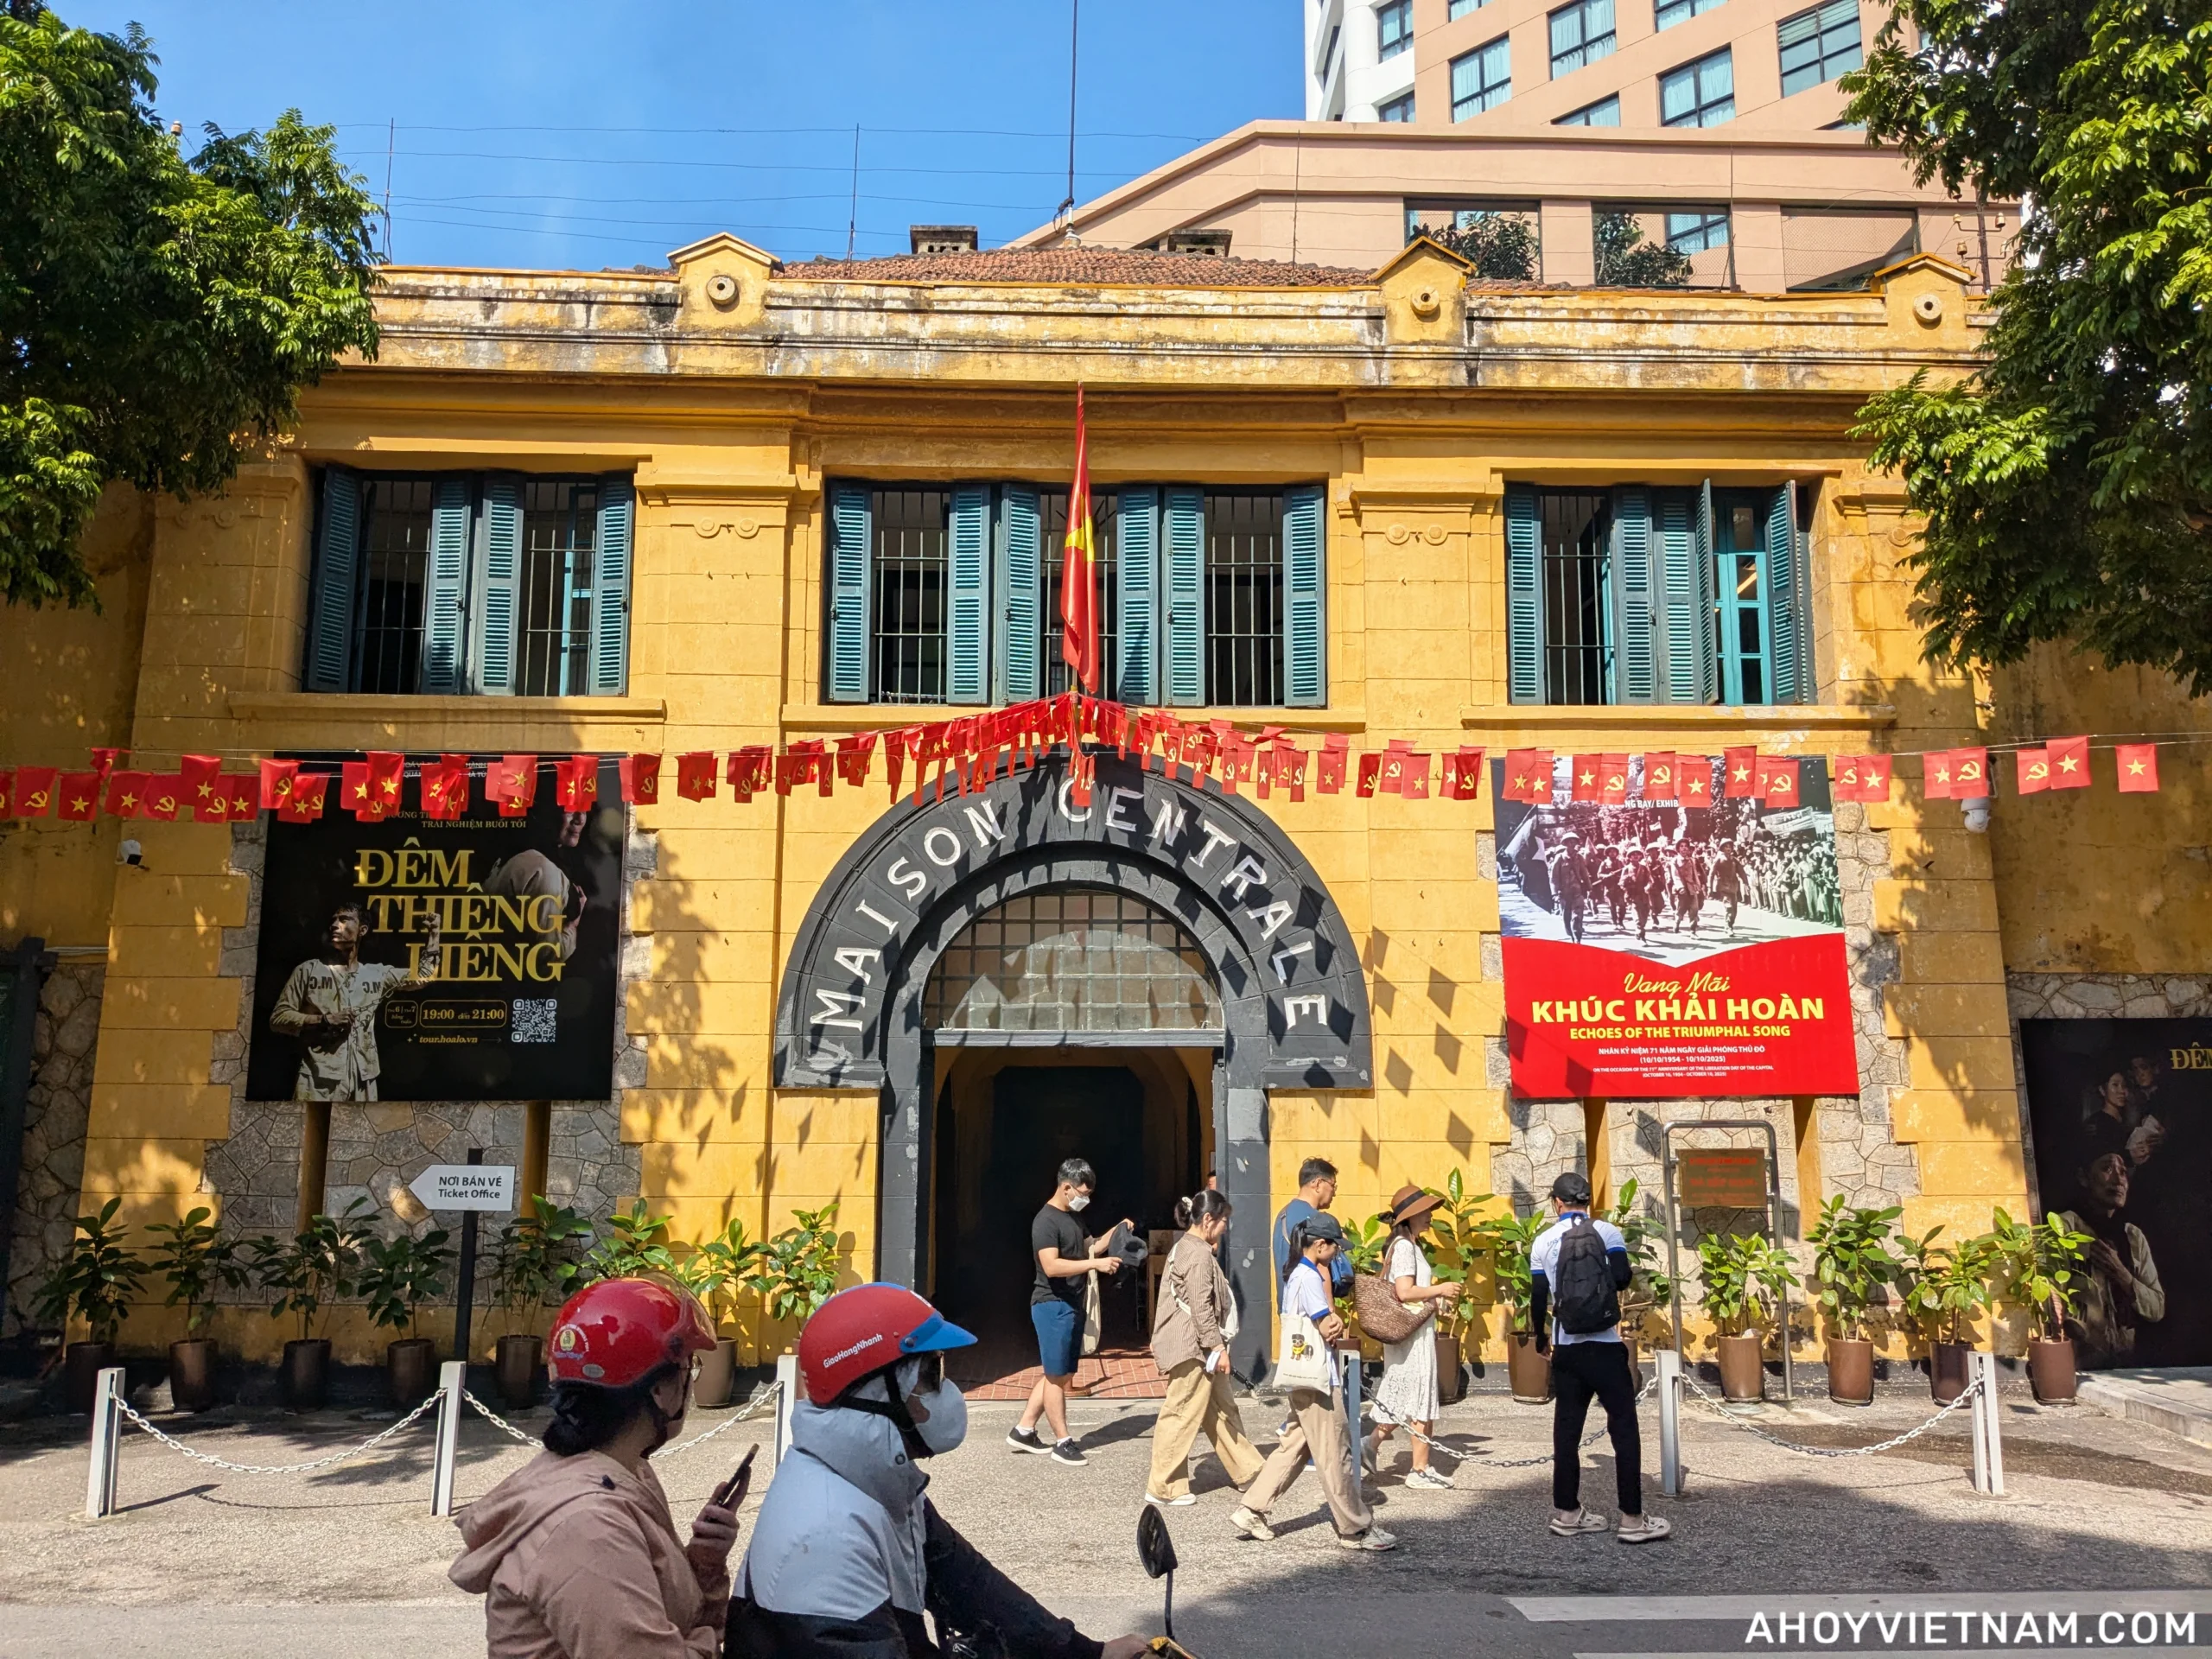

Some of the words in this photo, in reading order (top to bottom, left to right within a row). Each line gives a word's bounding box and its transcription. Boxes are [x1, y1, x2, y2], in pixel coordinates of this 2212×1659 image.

[1656, 799, 1679, 808] EXHIB
[445, 819, 483, 830] NGHIỆM
[511, 817, 526, 828] TỐI
[353, 836, 475, 888] ĐÊM
[366, 882, 568, 934] THIÊNG
[810, 798, 1007, 1032] MAISON
[1058, 777, 1328, 1031] CENTRALE
[405, 930, 567, 982] LIÊNG
[1624, 973, 1681, 999] Vang
[1687, 971, 1731, 993] Mãi
[423, 1009, 454, 1020] 19:00
[472, 1009, 504, 1020] 21:00
[1532, 995, 1626, 1024] KHÚC
[1635, 993, 1719, 1023] KHẢI
[1727, 993, 1824, 1020] HOÀN
[1570, 1028, 1623, 1039] ECHOES
[1625, 1028, 1643, 1039] OF
[1646, 1027, 1670, 1039] THE
[1673, 1026, 1751, 1038] TRIUMPHAL
[1753, 1026, 1790, 1037] SONG
[419, 1035, 478, 1044] tour.hoalo.vn
[1631, 1046, 1649, 1055] NIỆM
[439, 1176, 459, 1185] NƠI
[462, 1175, 485, 1186] BÁN
[488, 1176, 502, 1186] VÉ
[438, 1189, 468, 1198] Ticket
[471, 1189, 500, 1198] Office
[823, 1333, 882, 1368] GiaoHangNhanh
